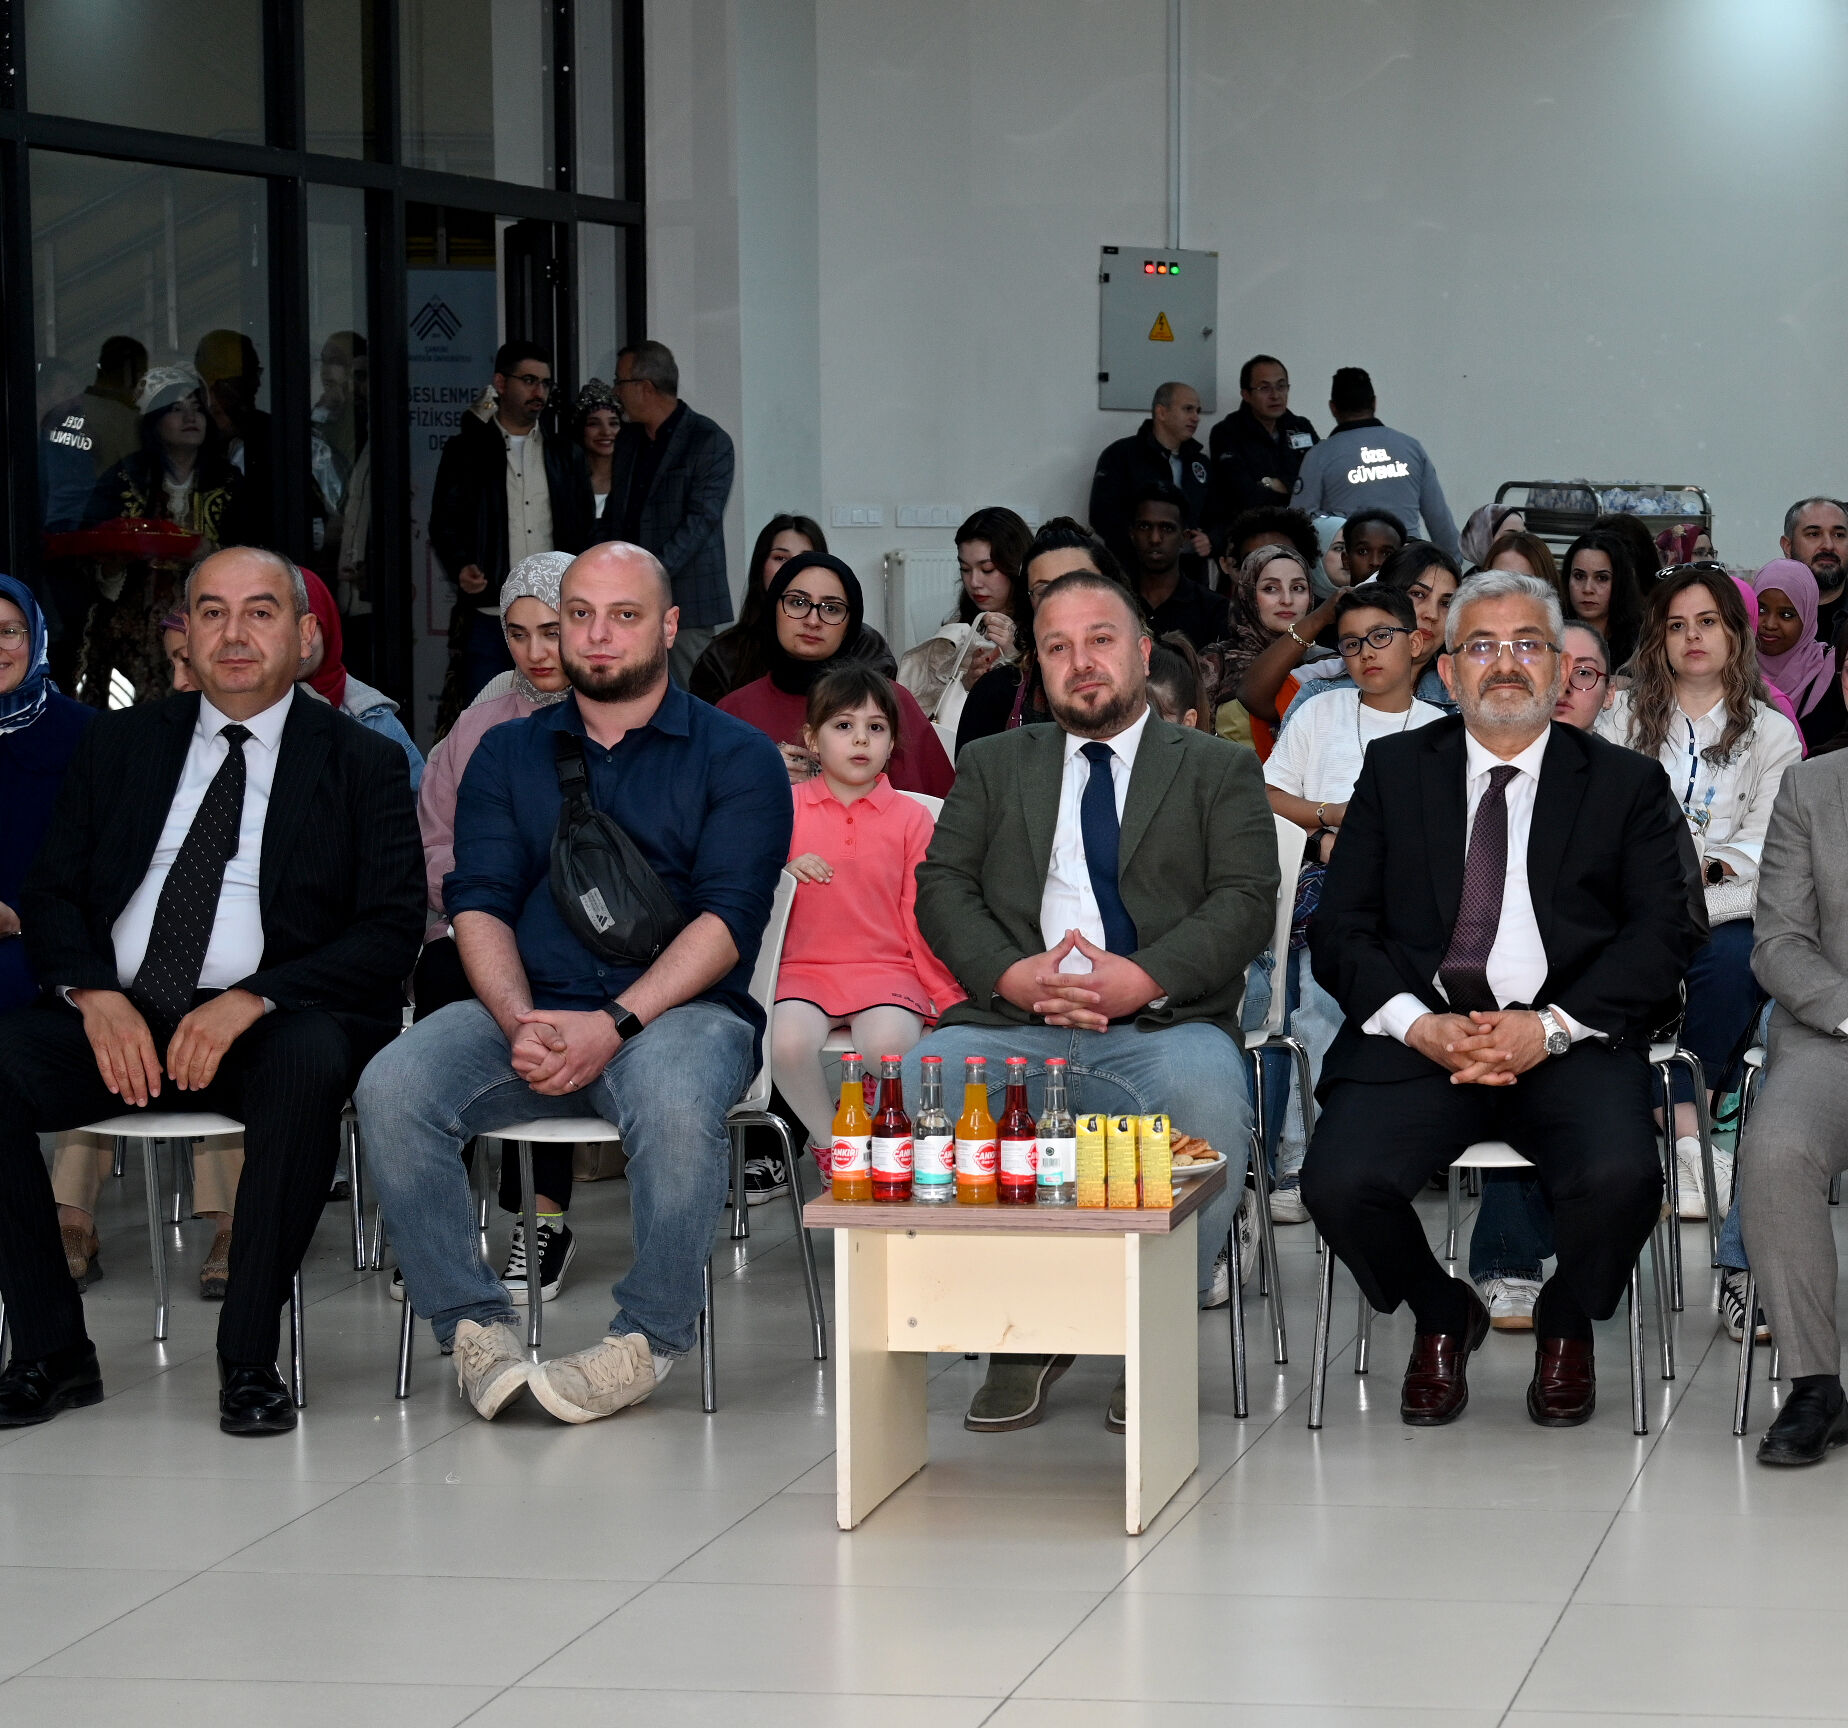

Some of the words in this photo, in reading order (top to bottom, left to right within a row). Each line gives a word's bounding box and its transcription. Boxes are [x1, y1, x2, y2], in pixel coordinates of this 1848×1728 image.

[409, 407, 461, 427] FİZİKSE
[1360, 446, 1391, 464] ÖZEL
[1347, 461, 1410, 484] GÜVENLİK
